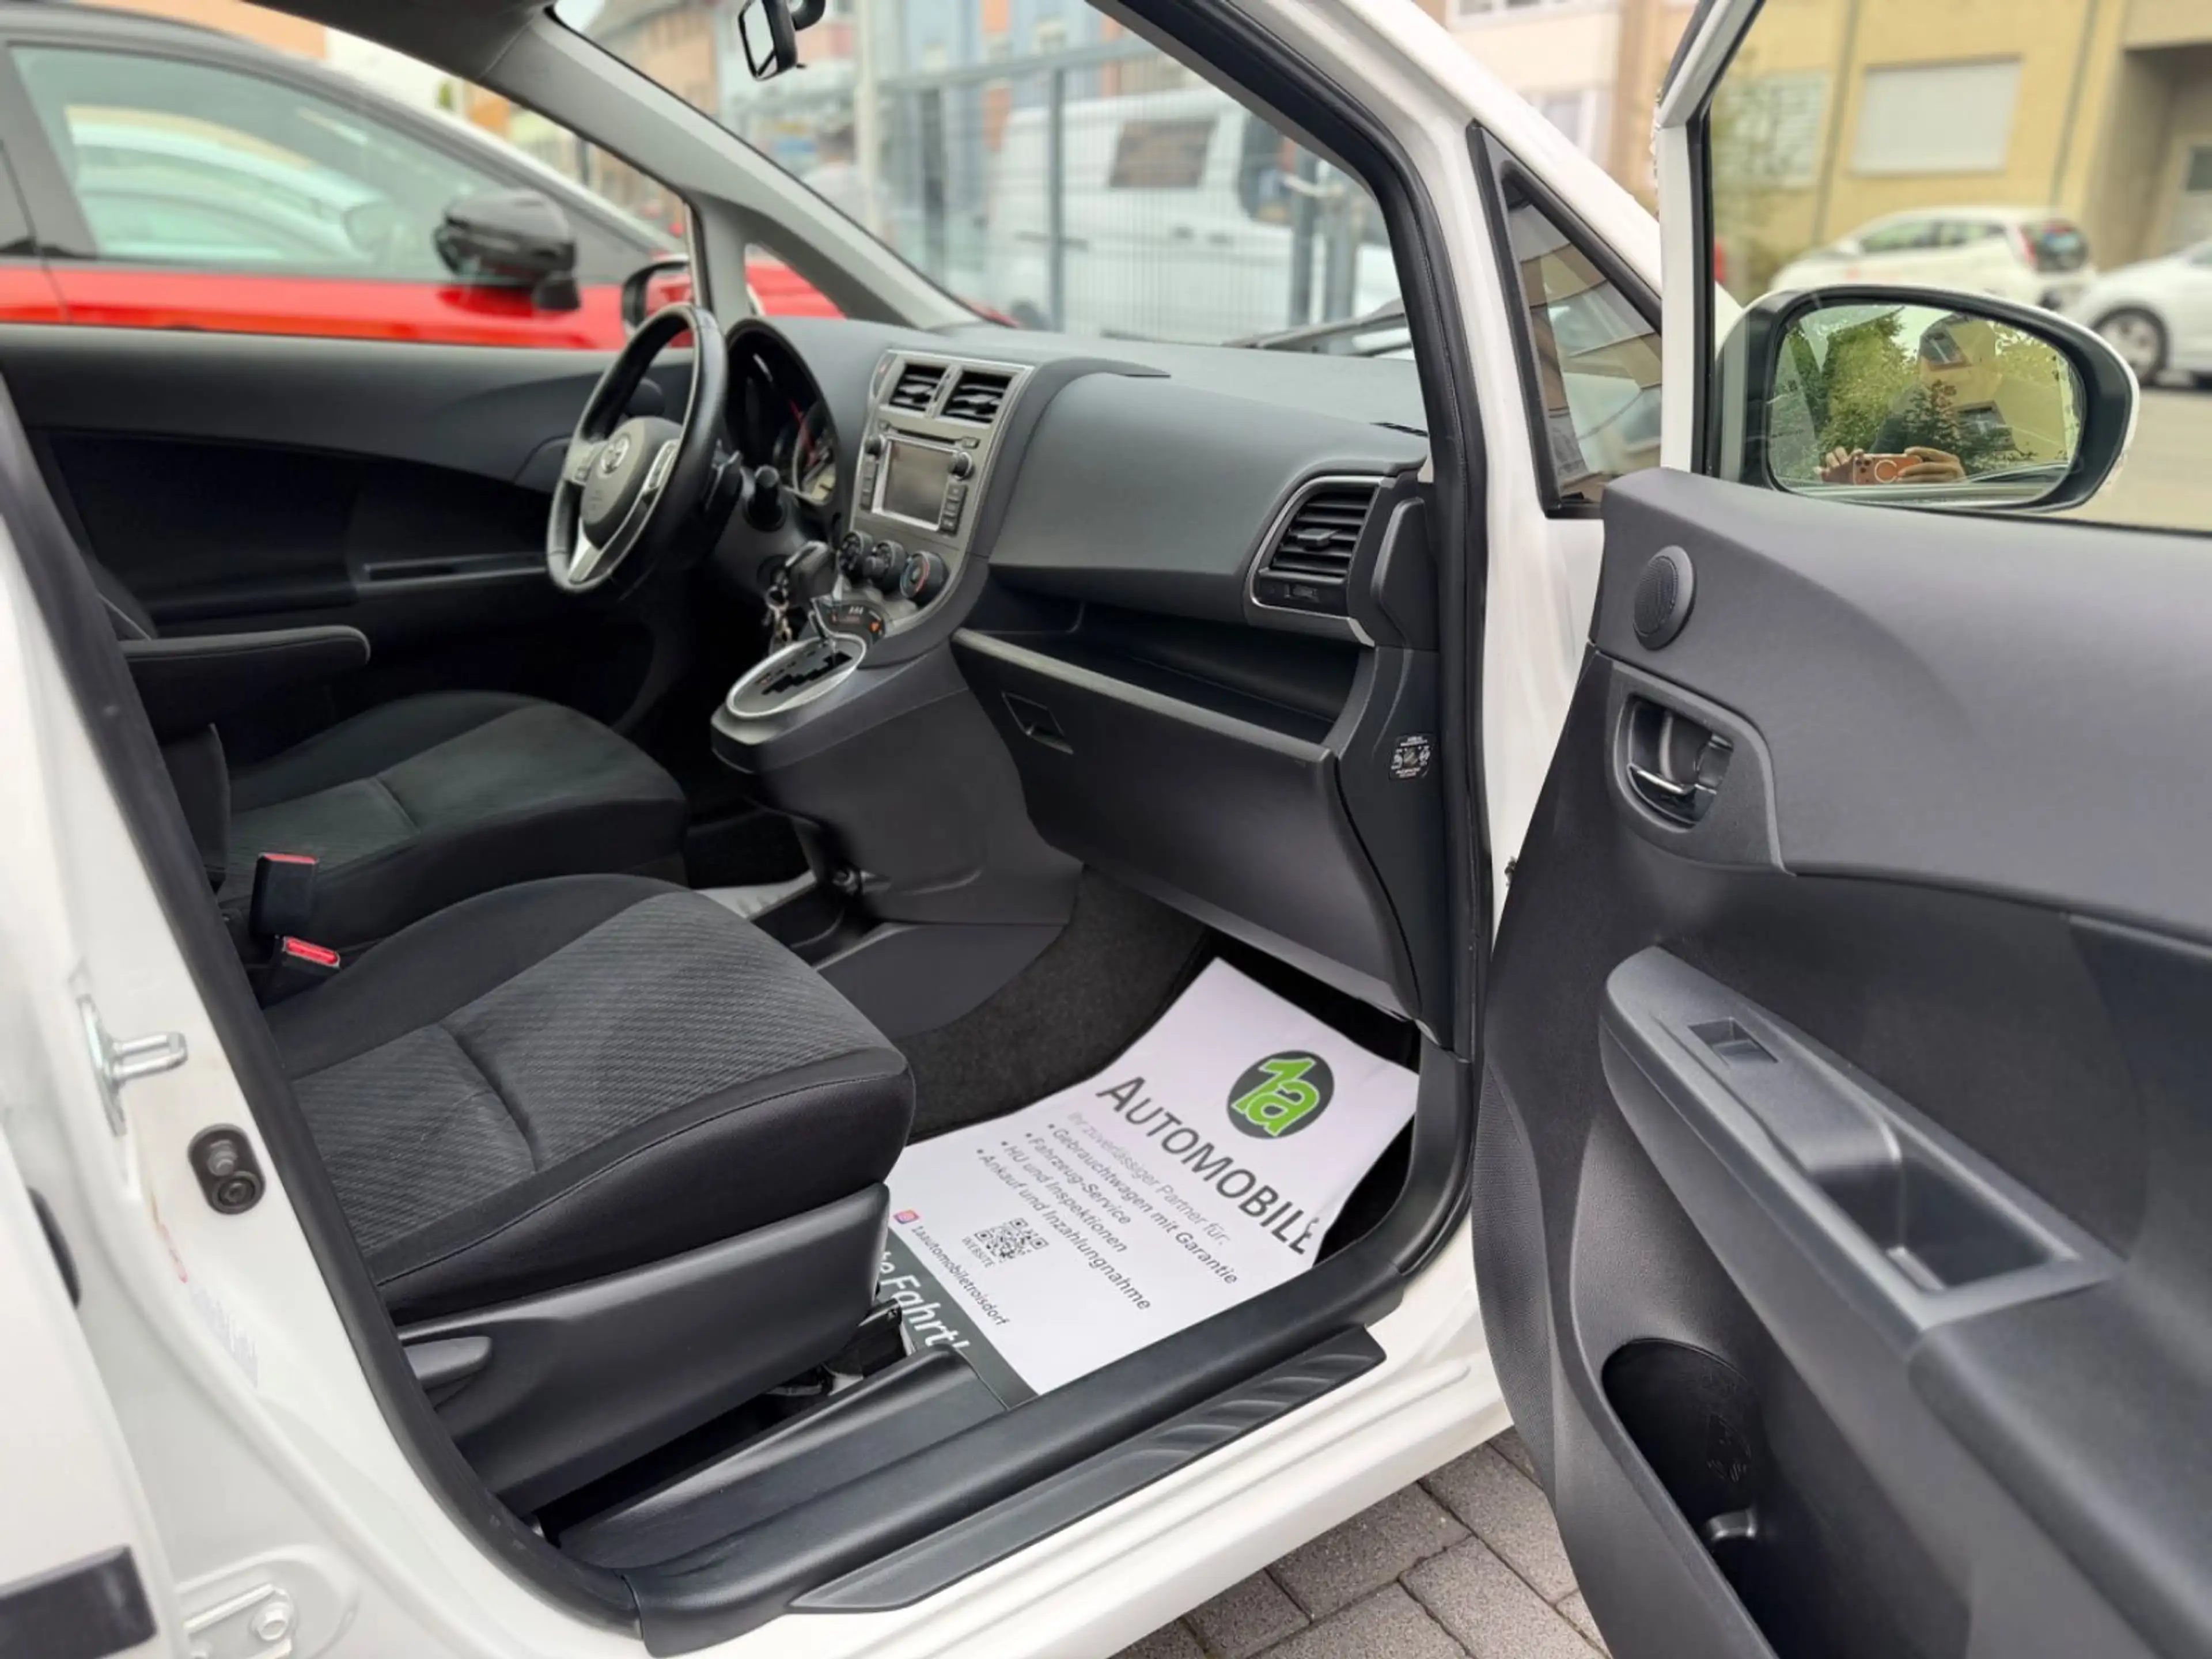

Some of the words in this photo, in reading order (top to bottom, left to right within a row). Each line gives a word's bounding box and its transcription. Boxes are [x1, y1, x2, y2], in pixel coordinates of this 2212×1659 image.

[1231, 1058, 1320, 1137] 1a
[1005, 1145, 1029, 1163] HU
[1023, 1162, 1054, 1184] und
[1044, 1181, 1128, 1253] Inspektionen
[1028, 1137, 1131, 1225] Fahrzeug-Service
[1052, 1127, 1154, 1214] Gebrauchtwagen
[1150, 1211, 1180, 1234] mit
[1175, 1231, 1238, 1285] Garantie
[1155, 1184, 1209, 1227] Partner
[979, 1156, 1028, 1190] Ankauf
[1018, 1188, 1051, 1211] und
[1042, 1210, 1152, 1310] Inzahlungnahme
